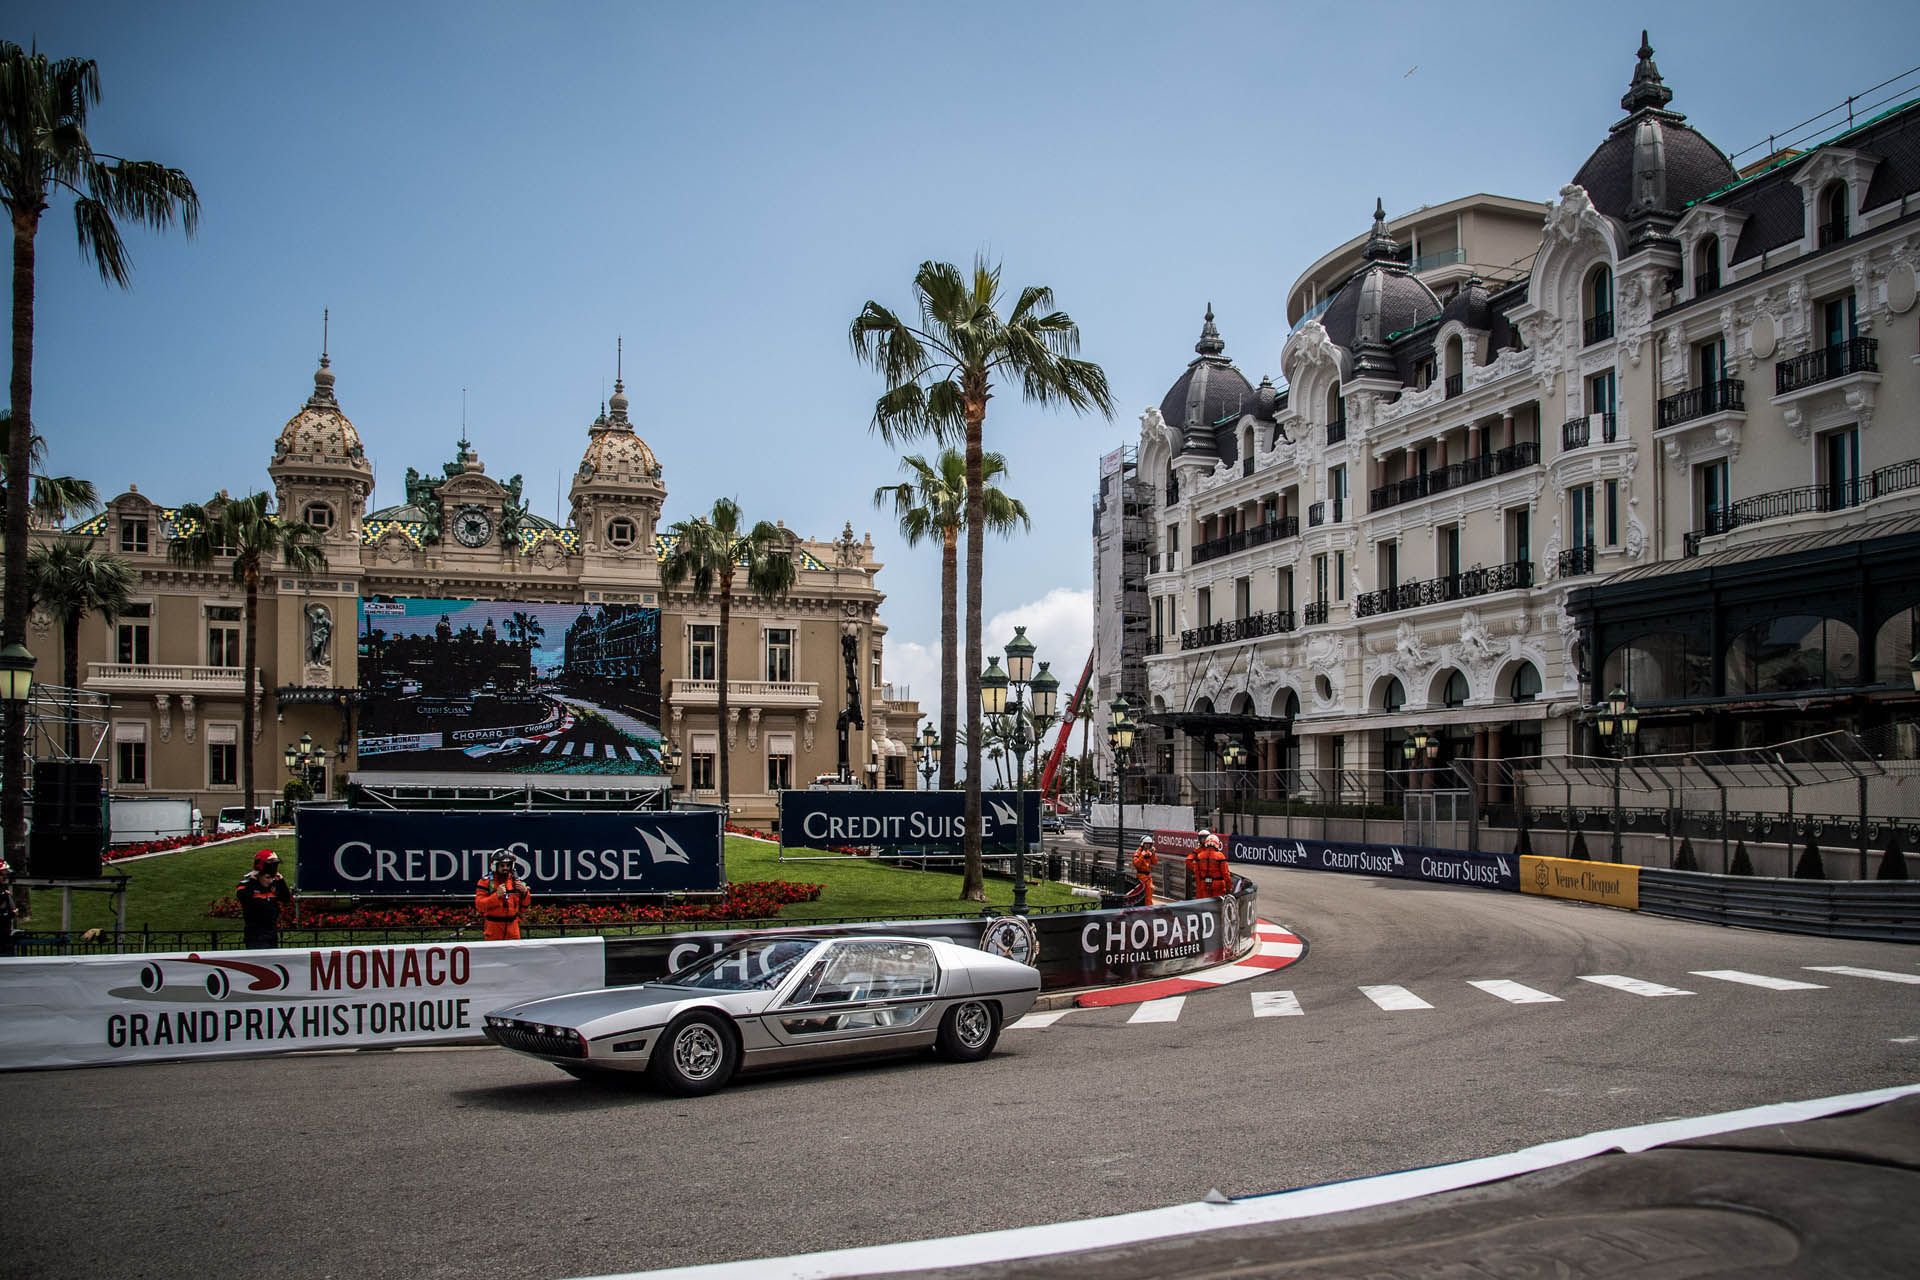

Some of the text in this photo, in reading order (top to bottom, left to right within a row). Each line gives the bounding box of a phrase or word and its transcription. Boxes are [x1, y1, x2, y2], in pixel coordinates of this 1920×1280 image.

[452, 730, 503, 740] CHOPARD
[803, 811, 994, 839] CREDIT SUISE
[1157, 835, 1174, 847] CASINO
[1175, 837, 1182, 847] DE
[1235, 842, 1269, 862] CREDIT
[1269, 845, 1297, 864] SUISSE
[334, 841, 643, 882] CREDIT SUISSE
[1323, 849, 1393, 872] CREDIT SUISSE
[1421, 856, 1499, 884] CREDIT SUISSE
[1554, 867, 1620, 897] Veuve Clicquot
[1081, 911, 1215, 954] CHOPARD
[1105, 943, 1200, 965] OFFICIAL TIMEKEEPER
[310, 946, 470, 991] MONACO
[107, 998, 471, 1048] GRAND PRIX HISTORIQUE
